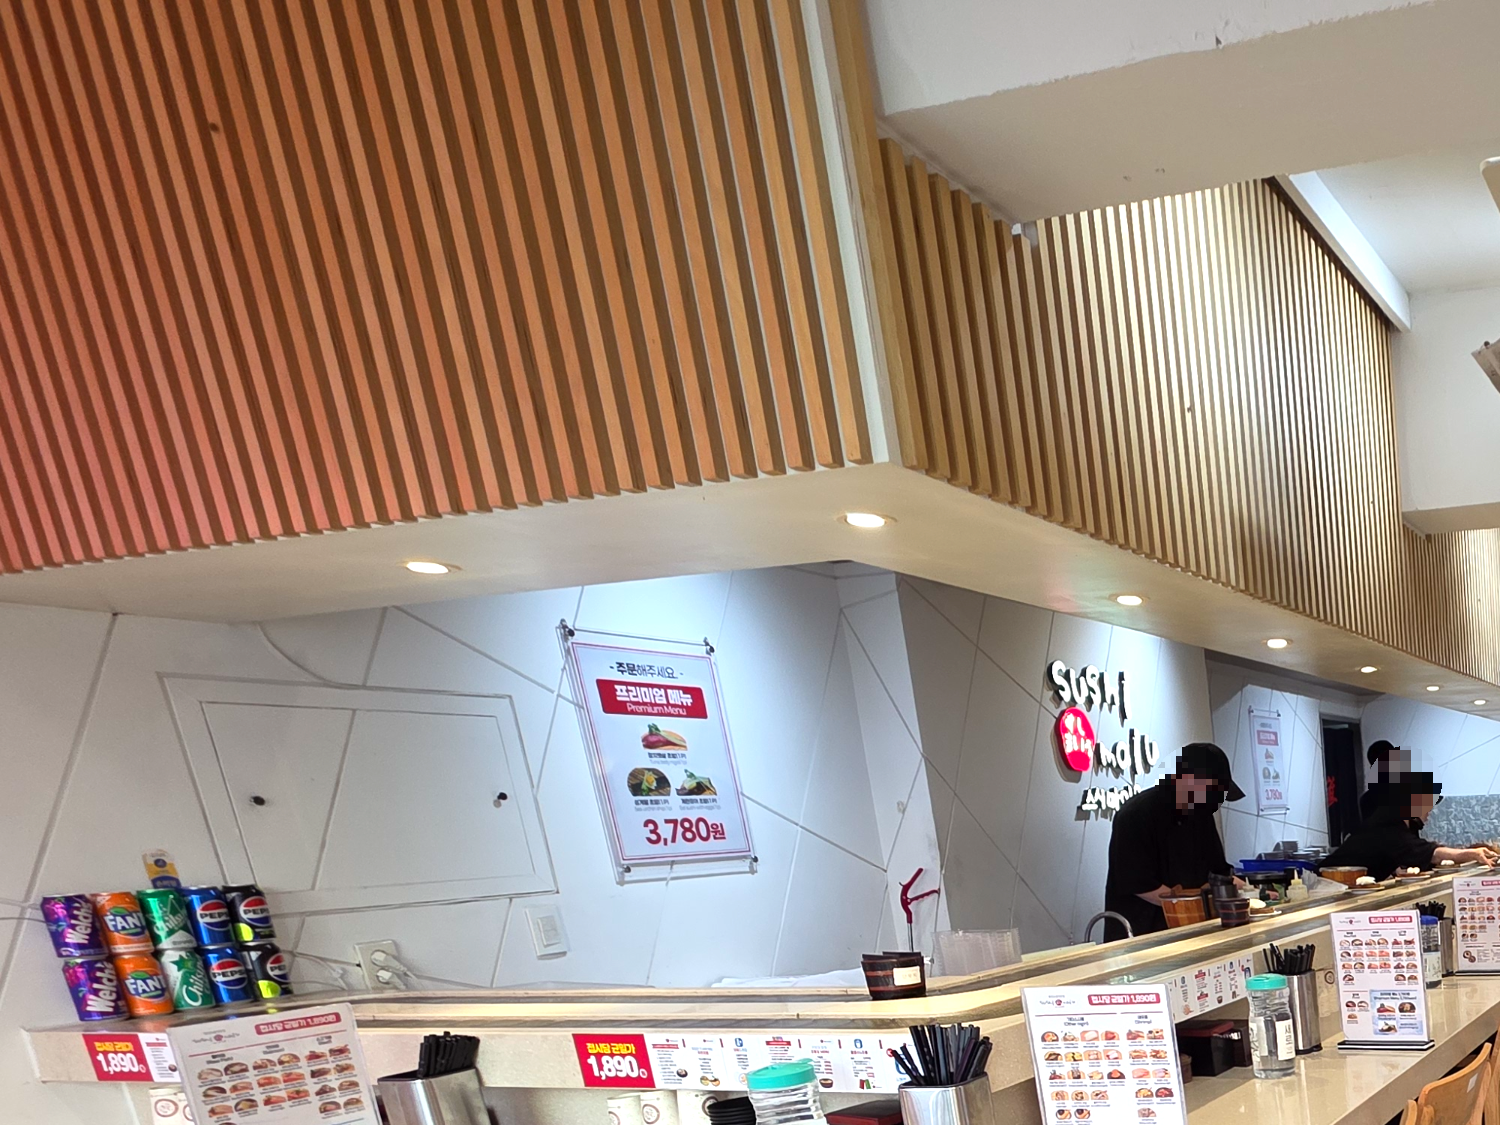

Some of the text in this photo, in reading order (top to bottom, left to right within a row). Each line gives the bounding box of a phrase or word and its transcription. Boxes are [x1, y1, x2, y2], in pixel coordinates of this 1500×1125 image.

[614, 684, 693, 706] 프리미엄 메뉴
[626, 703, 687, 716] Premium Menu
[643, 816, 727, 846] 3,780원
